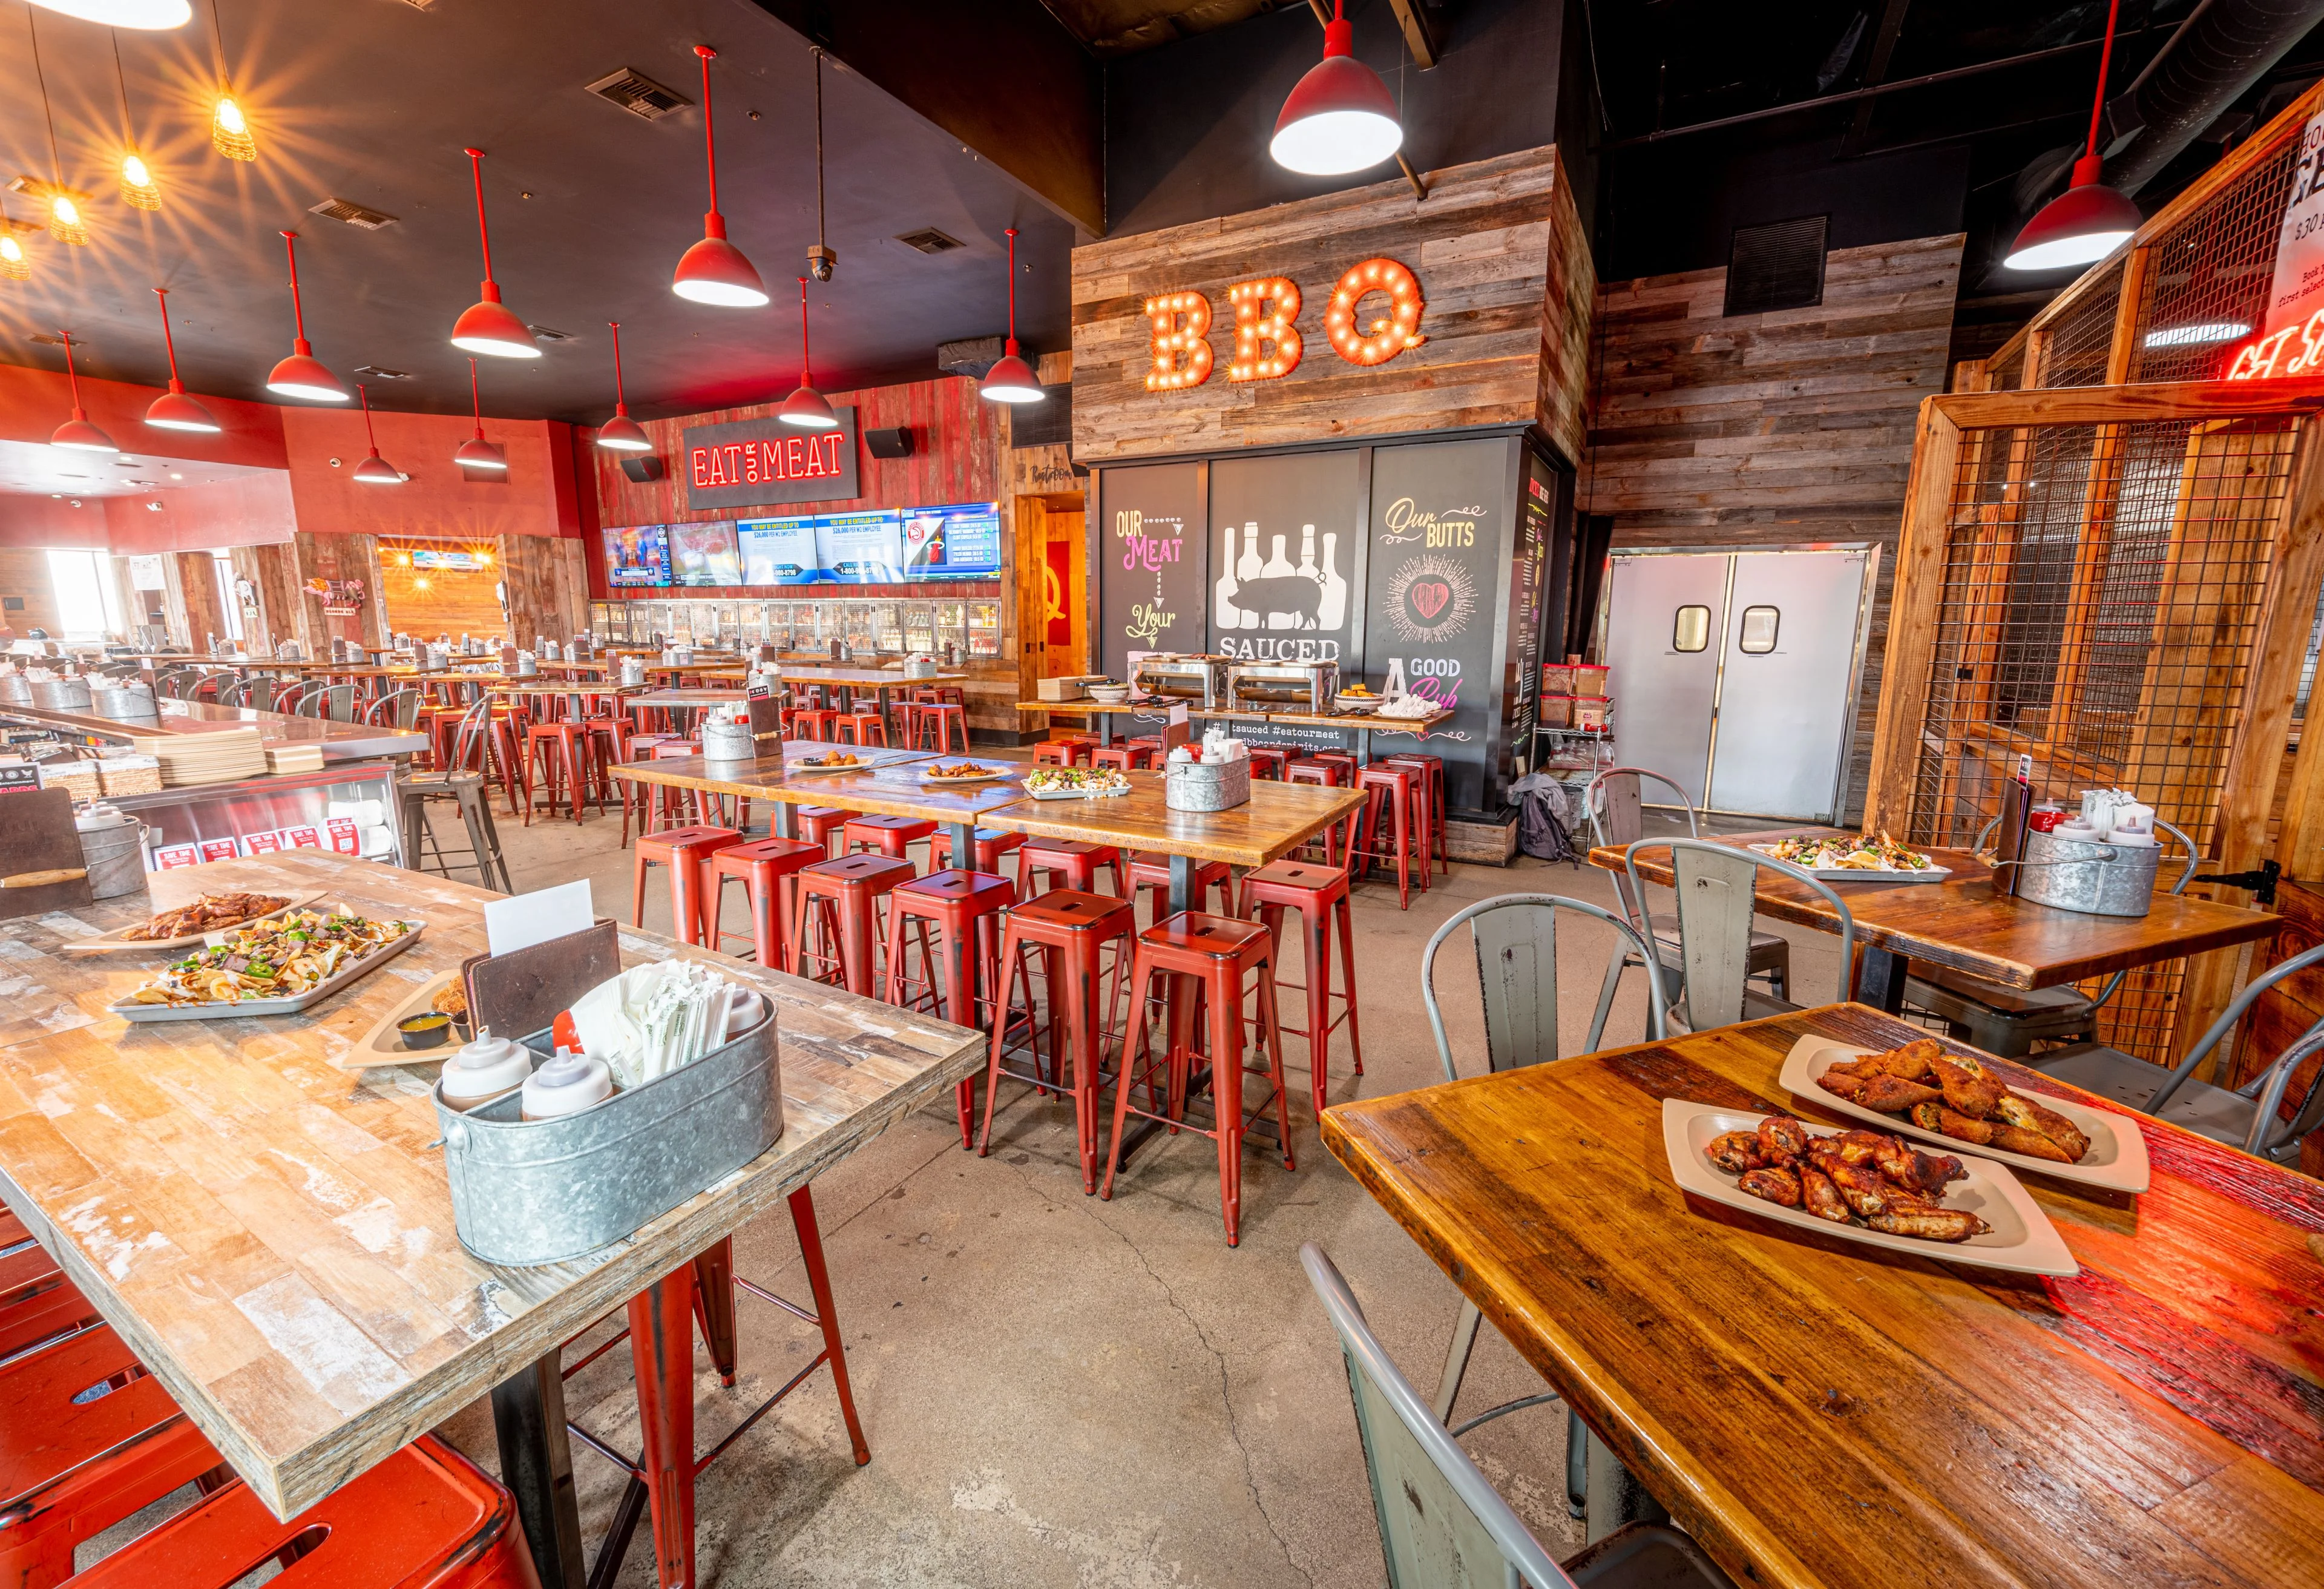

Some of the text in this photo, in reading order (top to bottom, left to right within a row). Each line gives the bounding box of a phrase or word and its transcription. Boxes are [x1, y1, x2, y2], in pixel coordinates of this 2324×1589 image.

[2300, 125, 2324, 159] HO
[2295, 213, 2319, 240] $30
[2302, 266, 2319, 283] Book
[2278, 292, 2299, 308] first
[1146, 258, 1426, 392] BBQ
[2227, 326, 2299, 380] GET
[692, 433, 844, 487] EAT OUR MEAT
[1117, 510, 1143, 538] OUR
[1385, 498, 1437, 534] Our
[1426, 522, 1475, 548] BUTTS
[1126, 604, 1176, 638] Your
[1219, 637, 1340, 661] SAUCED
[1382, 658, 1460, 705] A GOOD
[1213, 722, 1340, 739] #tsauced #eatourmeat
[163, 851, 177, 860] SAVE
